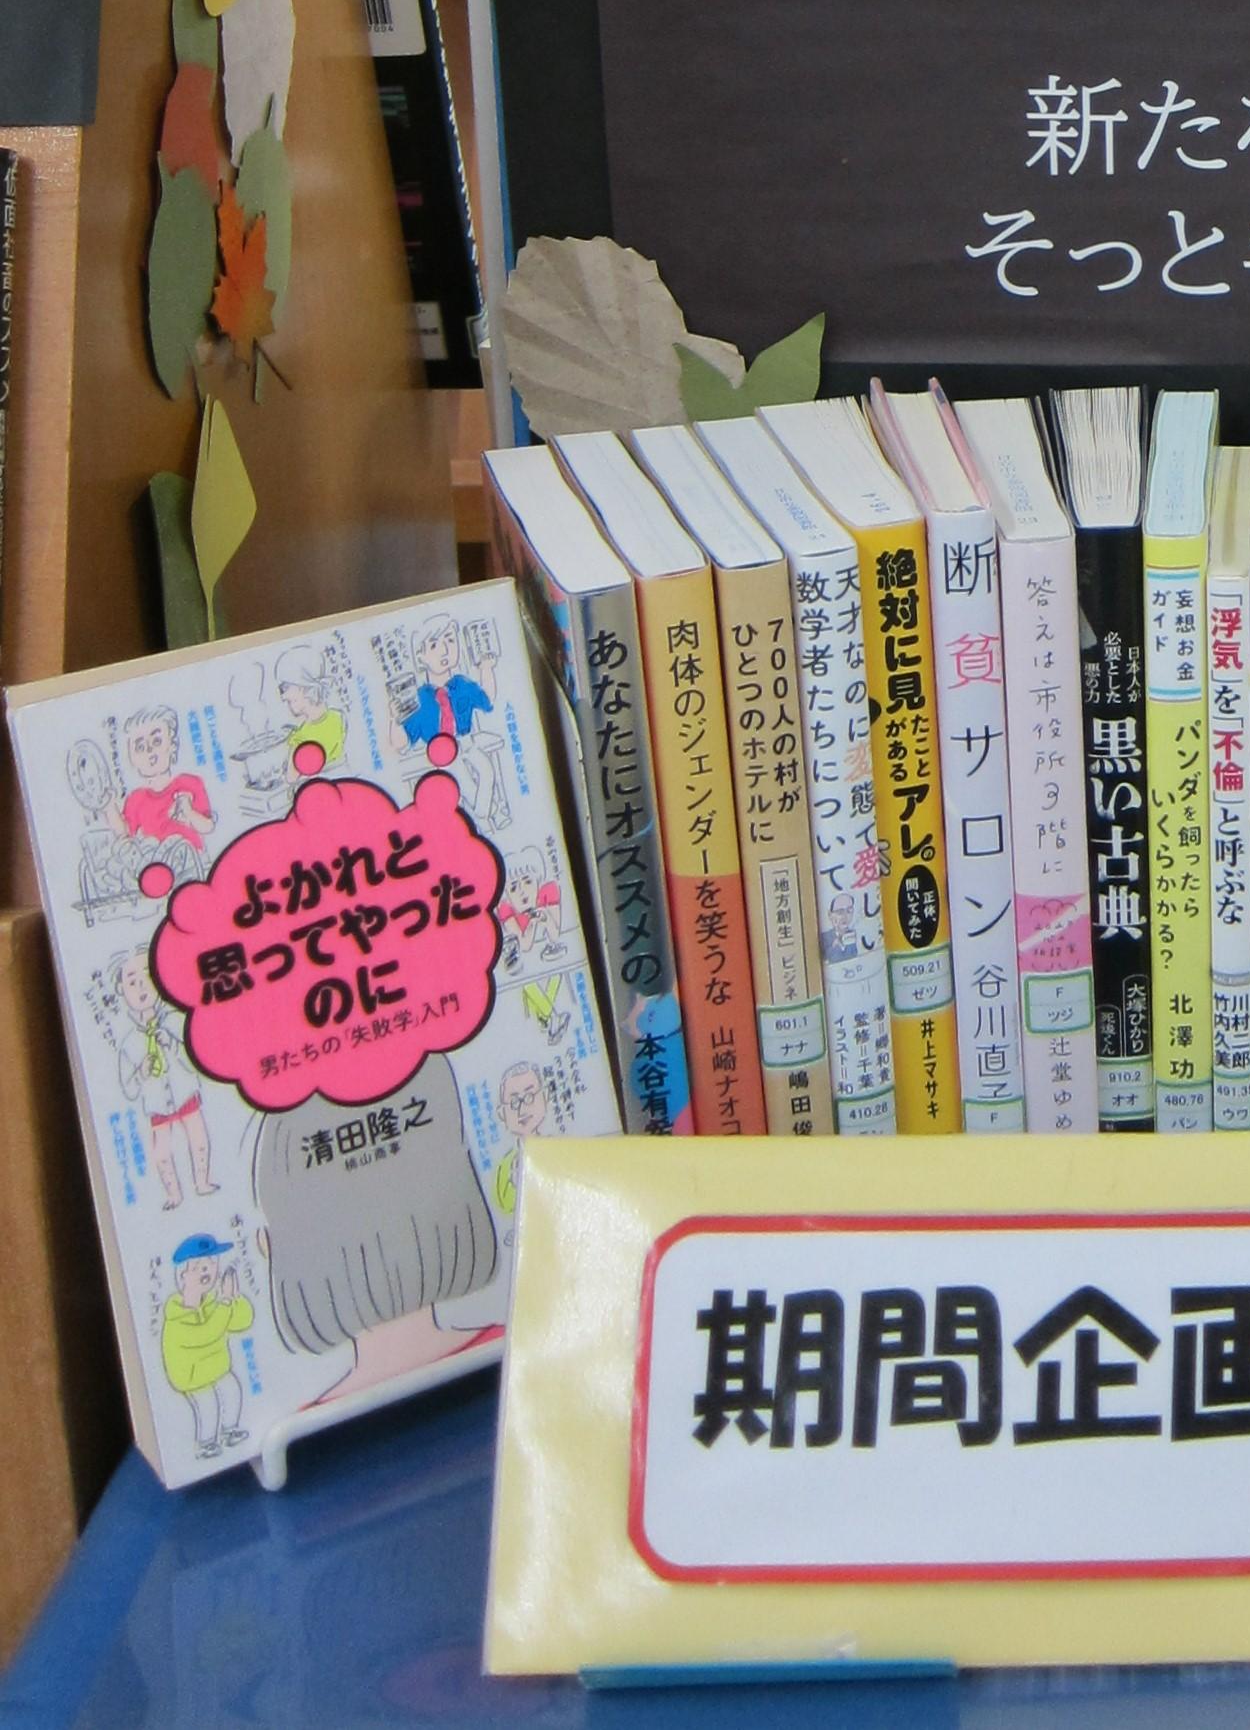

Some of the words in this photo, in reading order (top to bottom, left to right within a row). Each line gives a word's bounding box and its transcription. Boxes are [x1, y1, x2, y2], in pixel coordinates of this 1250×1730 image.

[1152, 590, 1171, 653] ガイド
[1175, 589, 1195, 681] 妄想お金
[731, 624, 774, 843] ひとつのホテルに
[768, 619, 800, 814] 700人の村が
[797, 571, 845, 890] 数学者たちについて
[944, 537, 1012, 938] 断貧サロン
[1210, 593, 1245, 925] 「浮気」を「不倫」と呼ぶな
[588, 630, 661, 988] あなたにオススメの
[667, 619, 732, 1006] 肉体のジェンダーを笑うな
[1088, 717, 1147, 941] 黒い古典
[1175, 720, 1202, 918] パンダを飼ったら
[233, 830, 429, 928] よかれと
[1151, 789, 1176, 969] いくらかかる？
[197, 874, 482, 1005] 思ってやった
[903, 960, 941, 977] 509.21
[304, 960, 407, 1028] のに
[775, 1017, 808, 1031] 601.1
[912, 986, 938, 1001] ゼツ
[1047, 1009, 1074, 1021] ツジ
[1056, 987, 1064, 997] F
[1126, 983, 1147, 1054] 大塚ひかり
[780, 1041, 808, 1055] ナナ
[1169, 994, 1194, 1079] 北澤功
[1214, 993, 1231, 1069] 竹内久美
[1232, 994, 1250, 1069] 川村二郎
[919, 1020, 941, 1119] 井上マサキ
[1049, 1037, 1072, 1129] 辻堂ゆめ
[1109, 1071, 1141, 1083] 910.2
[1111, 1094, 1138, 1106] オオ
[301, 1097, 432, 1168] 清田隆之
[850, 1104, 888, 1120] 410.28
[990, 1113, 999, 1123] F
[1170, 1117, 1198, 1130] パン
